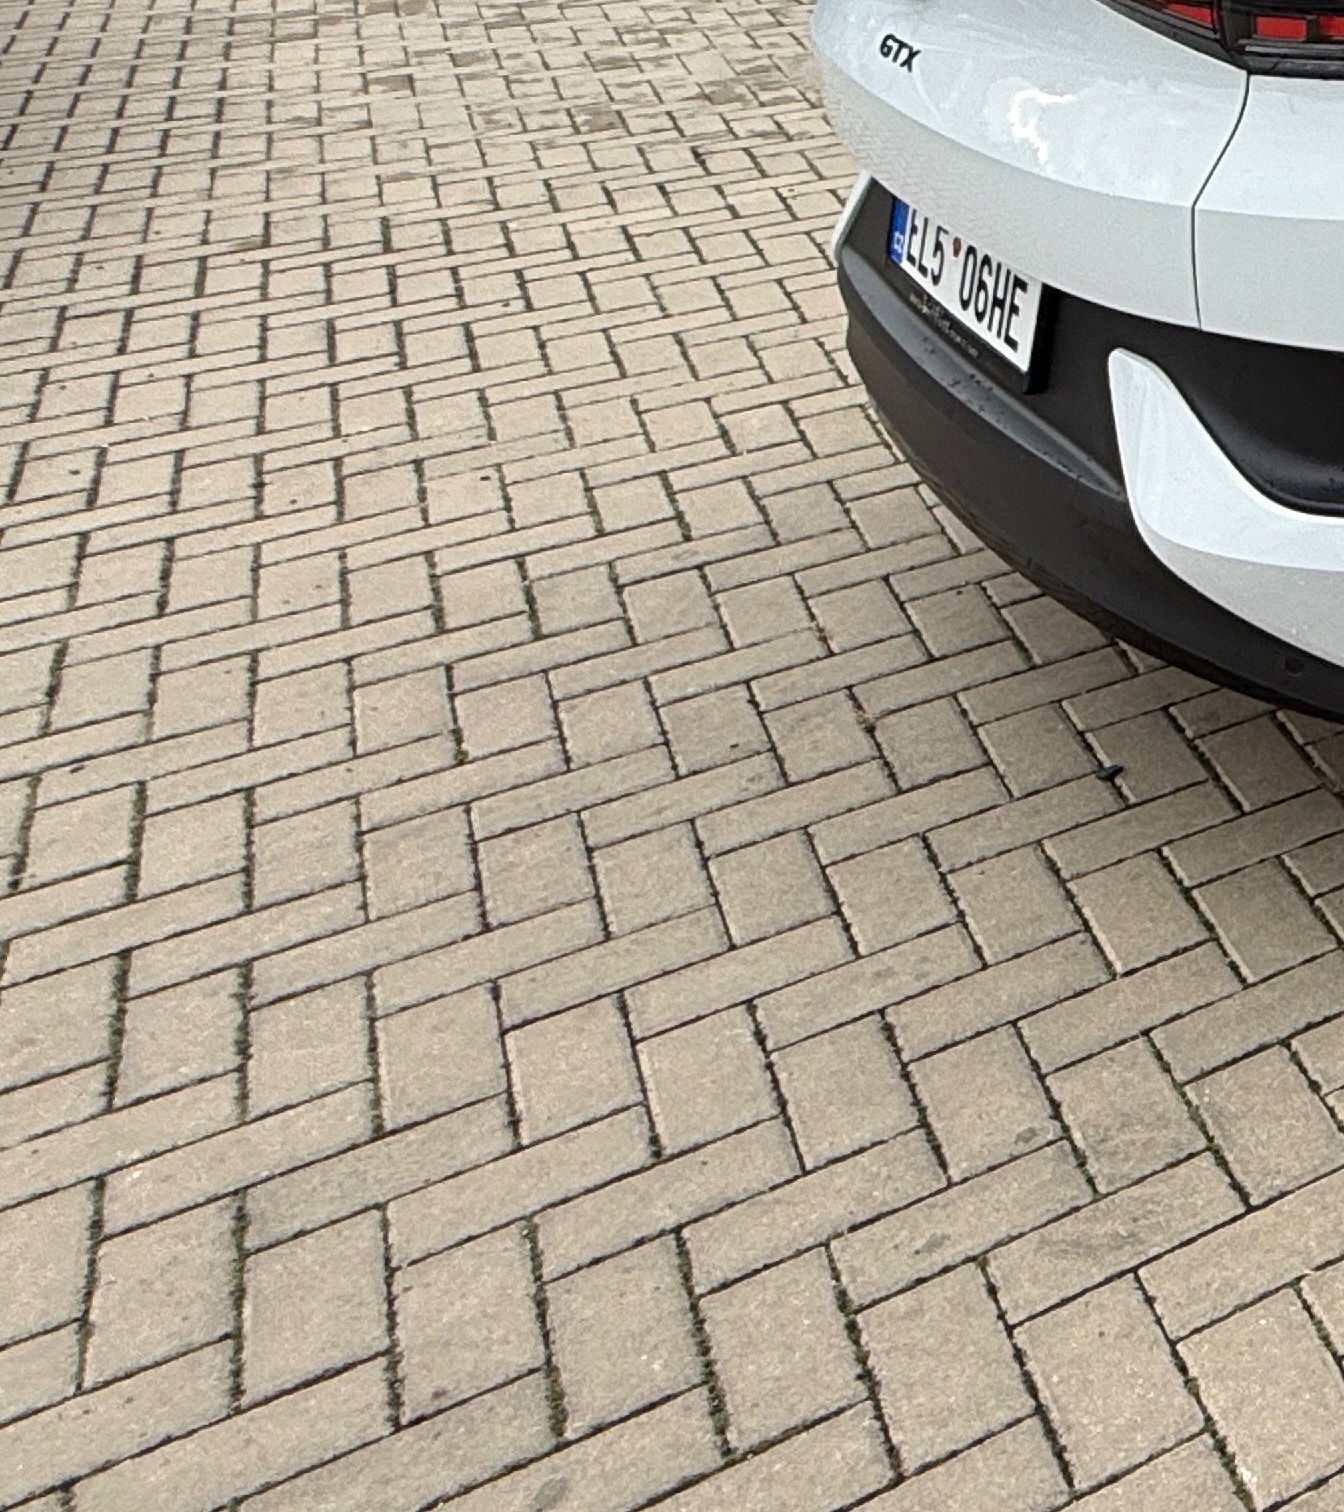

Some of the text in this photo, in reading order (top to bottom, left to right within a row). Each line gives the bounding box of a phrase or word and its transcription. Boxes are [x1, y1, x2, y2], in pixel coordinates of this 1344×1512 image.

[880, 33, 921, 73] GTX
[907, 208, 950, 286] EL5
[959, 244, 1028, 354] 06HE
